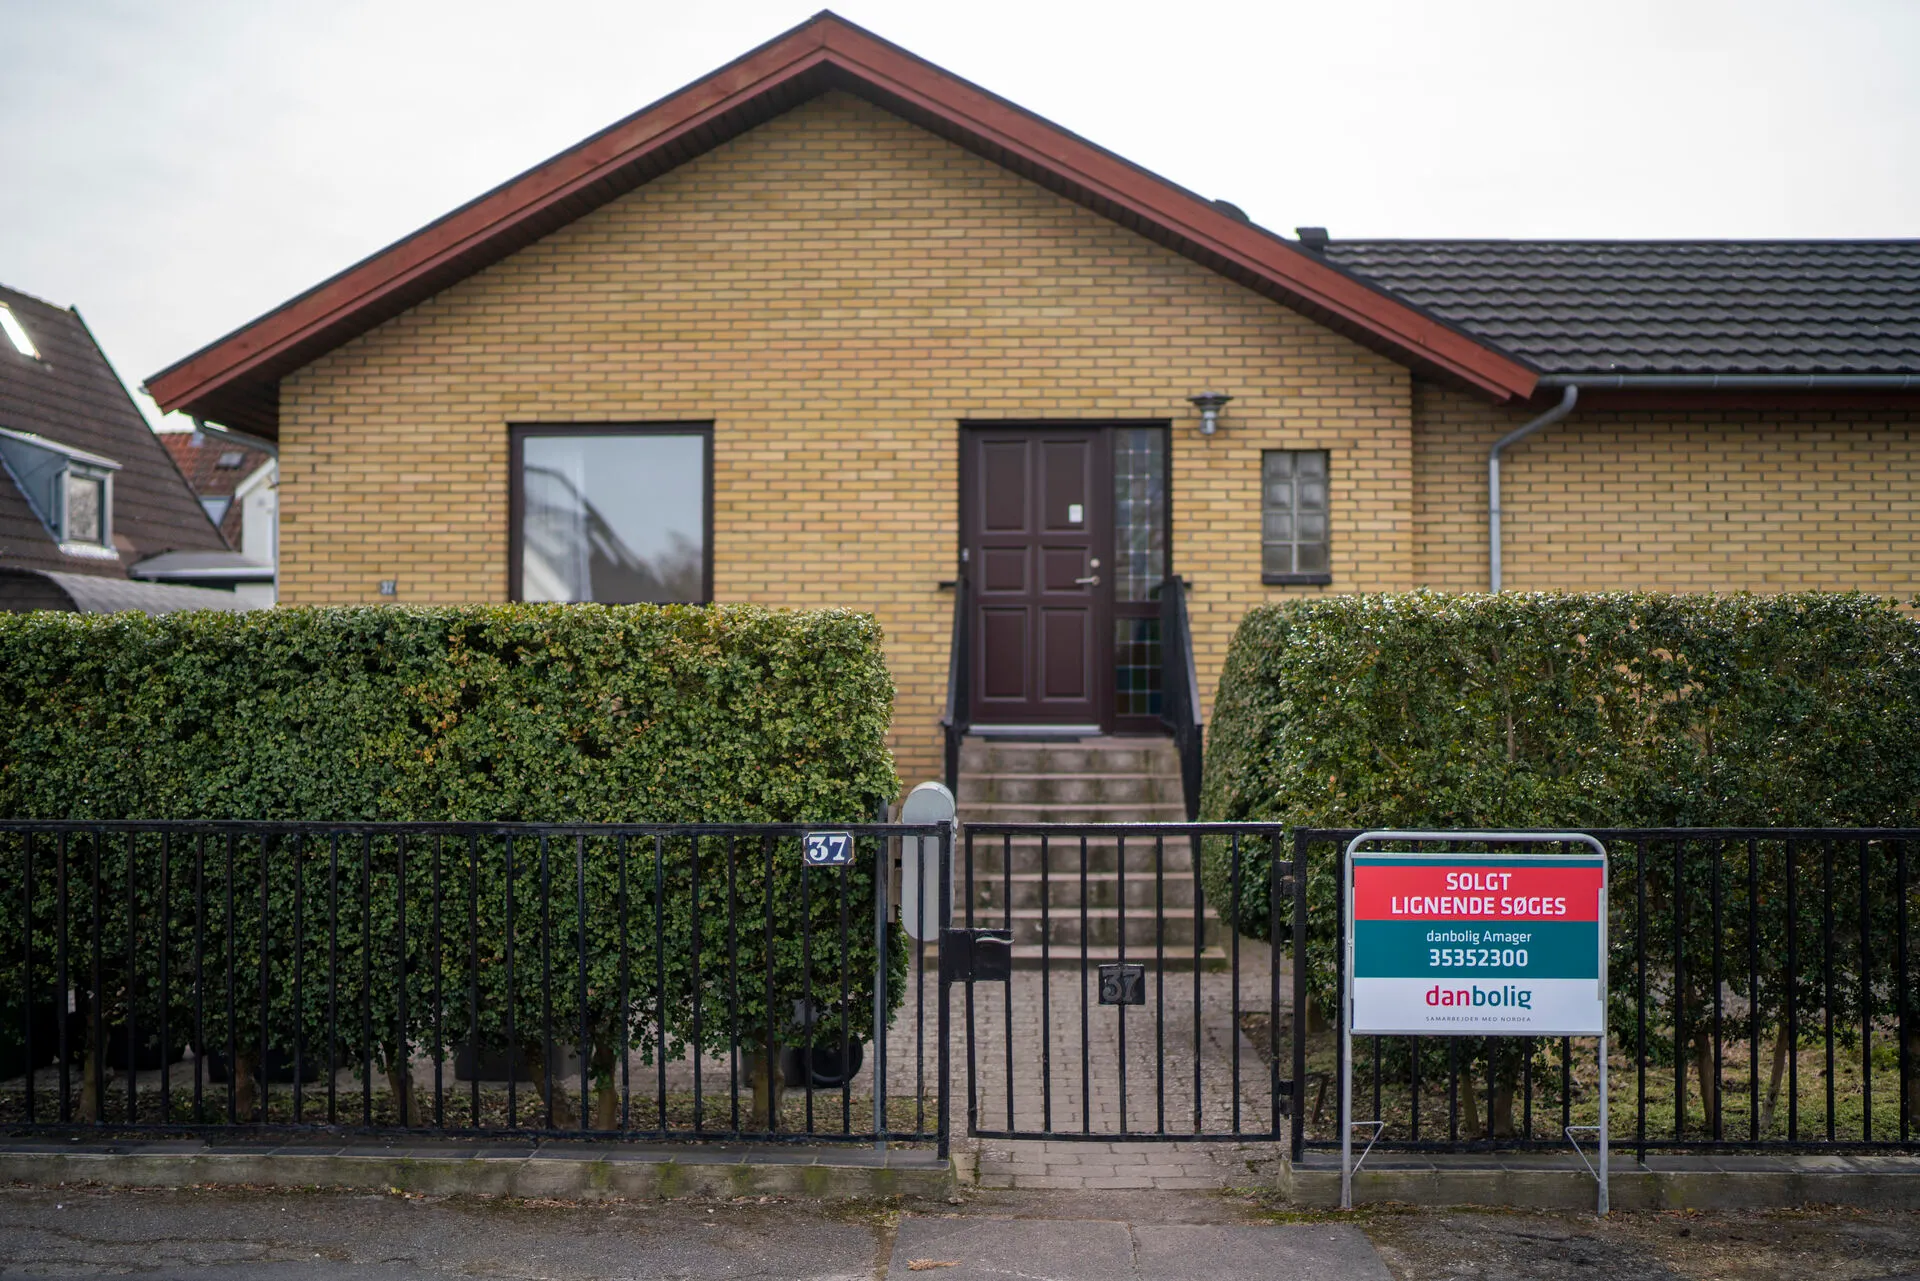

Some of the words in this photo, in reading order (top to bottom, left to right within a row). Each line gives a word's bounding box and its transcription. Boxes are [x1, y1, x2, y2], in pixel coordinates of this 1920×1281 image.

[808, 836, 847, 861] 37
[1446, 872, 1512, 891] SOLGT
[1391, 896, 1495, 915] LIGNENDE
[1500, 896, 1567, 916] SØGES
[1426, 930, 1480, 945] danbolig
[1483, 930, 1532, 945] Amager
[1429, 949, 1528, 967] 35352300
[1102, 968, 1141, 1002] 37
[1425, 985, 1532, 1010] danbolig
